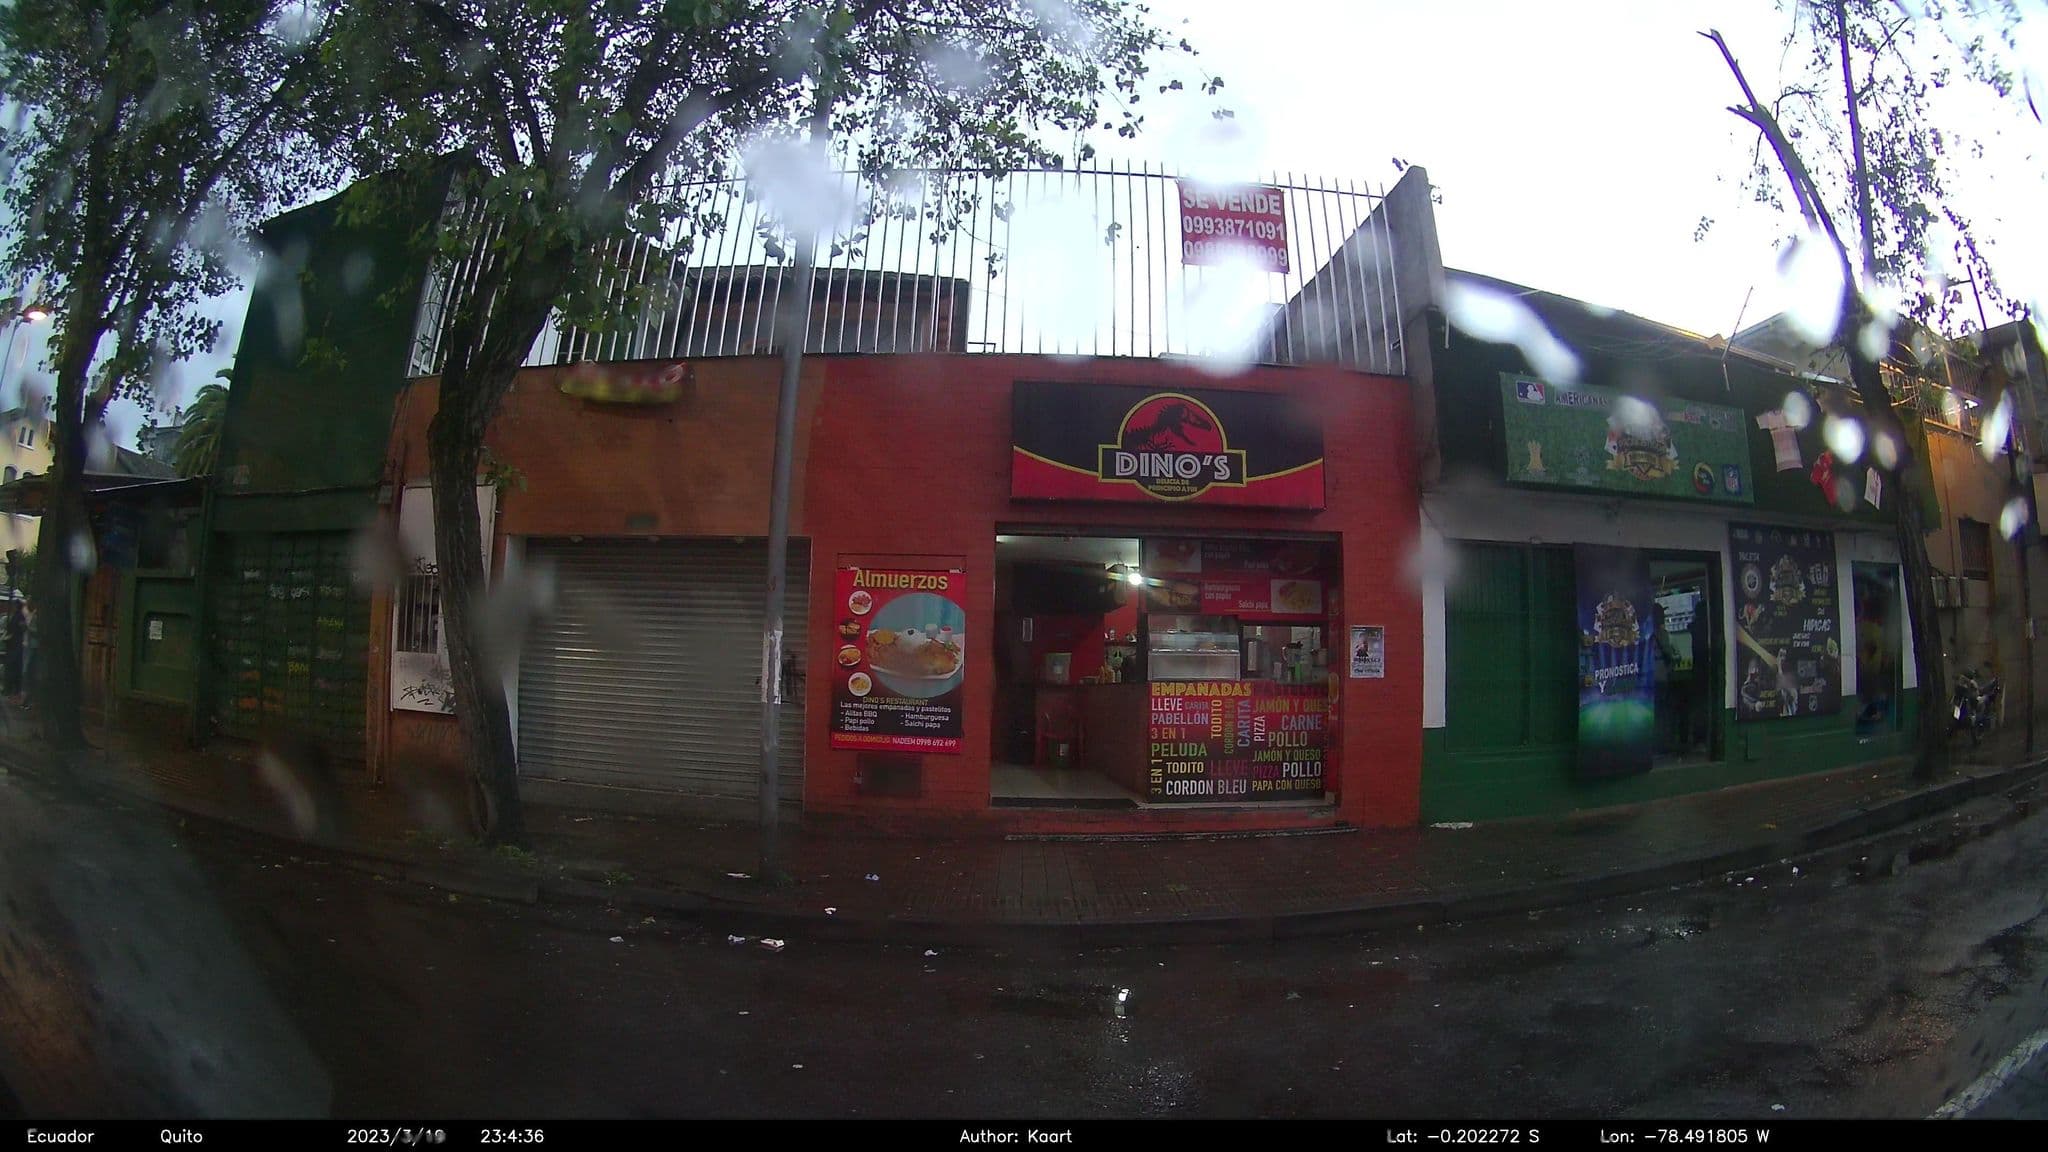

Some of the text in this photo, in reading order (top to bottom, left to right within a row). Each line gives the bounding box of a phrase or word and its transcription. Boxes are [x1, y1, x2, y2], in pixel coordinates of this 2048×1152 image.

[1183, 187, 1282, 216] SE VENDE
[1183, 215, 1285, 241] 0993871091
[1114, 451, 1231, 481] DINO'S
[853, 569, 949, 590] Almuerzos
[1151, 682, 1253, 697] EMPANADAS
[1599, 680, 1607, 693] Y
[852, 702, 878, 711] mejores
[879, 704, 915, 713] empanadas
[920, 705, 952, 714] pastelitos
[1151, 698, 1183, 711] LLEVE
[1255, 696, 1289, 712] JAMÓN
[1293, 698, 1299, 712] Y
[844, 717, 875, 727] Papi pollo
[905, 713, 950, 722] Hamburguesa
[1151, 711, 1208, 725] PABELLÓN
[1211, 699, 1223, 739] TODITO
[1237, 700, 1251, 747] CARITA
[1281, 714, 1322, 731] CARNE
[925, 722, 941, 730] papa
[1253, 715, 1266, 742] PIZZA
[1151, 728, 1186, 740] 3 EN 1
[1268, 731, 1308, 748] POLLO
[1151, 743, 1208, 757] PELUDA
[1252, 748, 1321, 762] JAMÓN Y QUESO
[1166, 761, 1205, 774] TODITO
[1282, 762, 1322, 778] POLLO
[1151, 769, 1162, 784] EN
[1166, 779, 1247, 796] CORDON BLEU
[1251, 778, 1321, 792] PAPA CON QUESO
